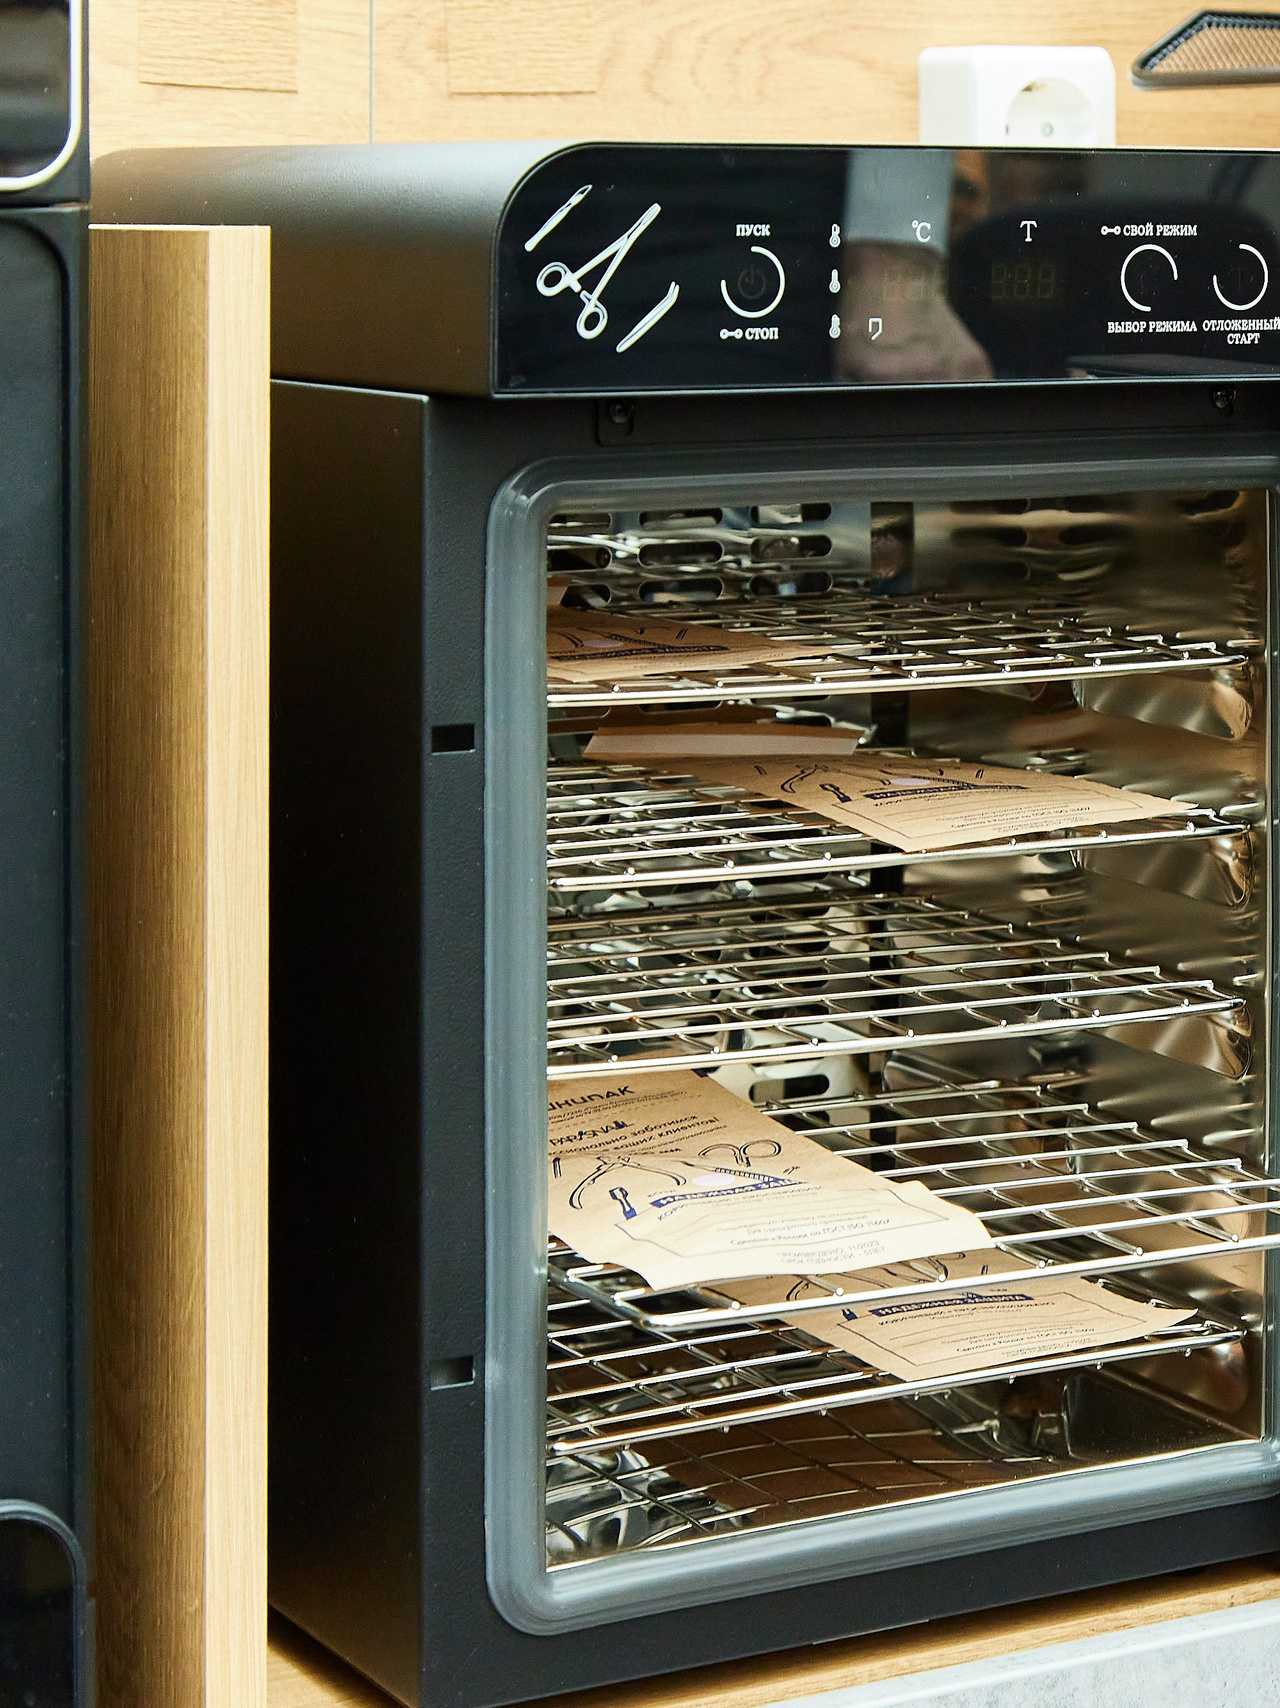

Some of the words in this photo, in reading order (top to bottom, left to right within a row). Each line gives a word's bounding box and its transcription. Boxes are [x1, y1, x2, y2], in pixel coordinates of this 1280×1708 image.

[735, 223, 771, 238] ПУСК
[1123, 222, 1154, 236] СВОЙ
[1156, 224, 1197, 236] РЕЖИМ
[745, 327, 779, 341] СТОП
[1107, 320, 1148, 334] ВЫБОР
[1149, 320, 1198, 333] РЕЖИМА
[1227, 332, 1260, 345] СТАРТ
[548, 1134, 628, 1156] ссионально
[631, 1114, 698, 1138] заботимся
